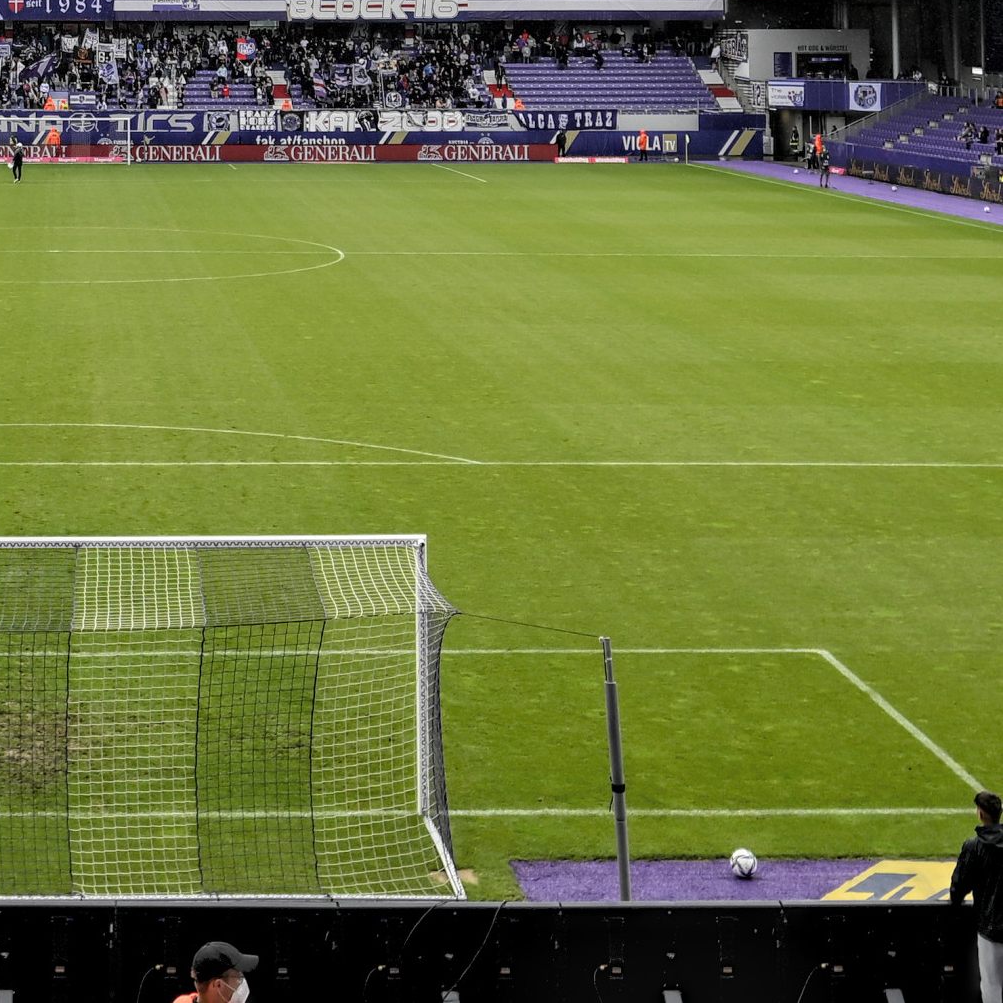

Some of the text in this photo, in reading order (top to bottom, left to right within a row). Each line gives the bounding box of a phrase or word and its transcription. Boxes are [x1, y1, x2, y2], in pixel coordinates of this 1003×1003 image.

[574, 111, 613, 128] TRAZ
[664, 139, 677, 152] TV
[135, 146, 222, 162] GENERALI
[290, 146, 376, 161] GENERALI
[443, 146, 530, 161] GENERALI
